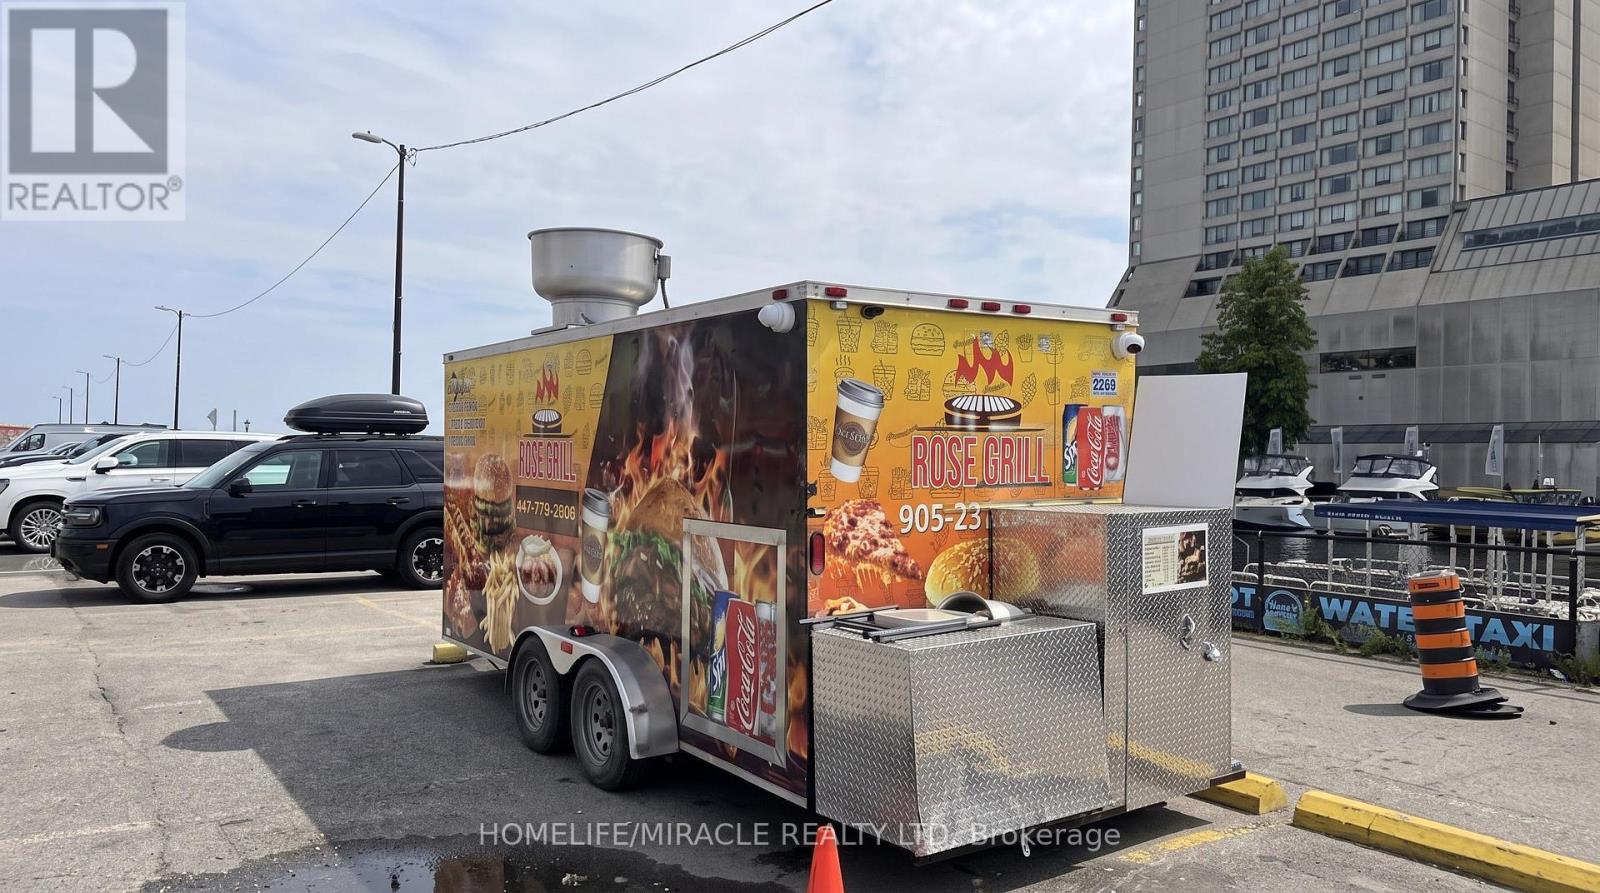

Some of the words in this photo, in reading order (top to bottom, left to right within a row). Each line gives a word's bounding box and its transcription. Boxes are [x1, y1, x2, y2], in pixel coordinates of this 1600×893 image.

[1092, 378, 1116, 391] 2269
[519, 440, 545, 480] ROSE
[546, 440, 577, 482] GRILL
[911, 435, 977, 488] ROSE
[983, 435, 1050, 485] GRILL
[899, 502, 989, 534] 905-23
[1319, 596, 1416, 632] WATE
[1465, 614, 1555, 651] TAXI
